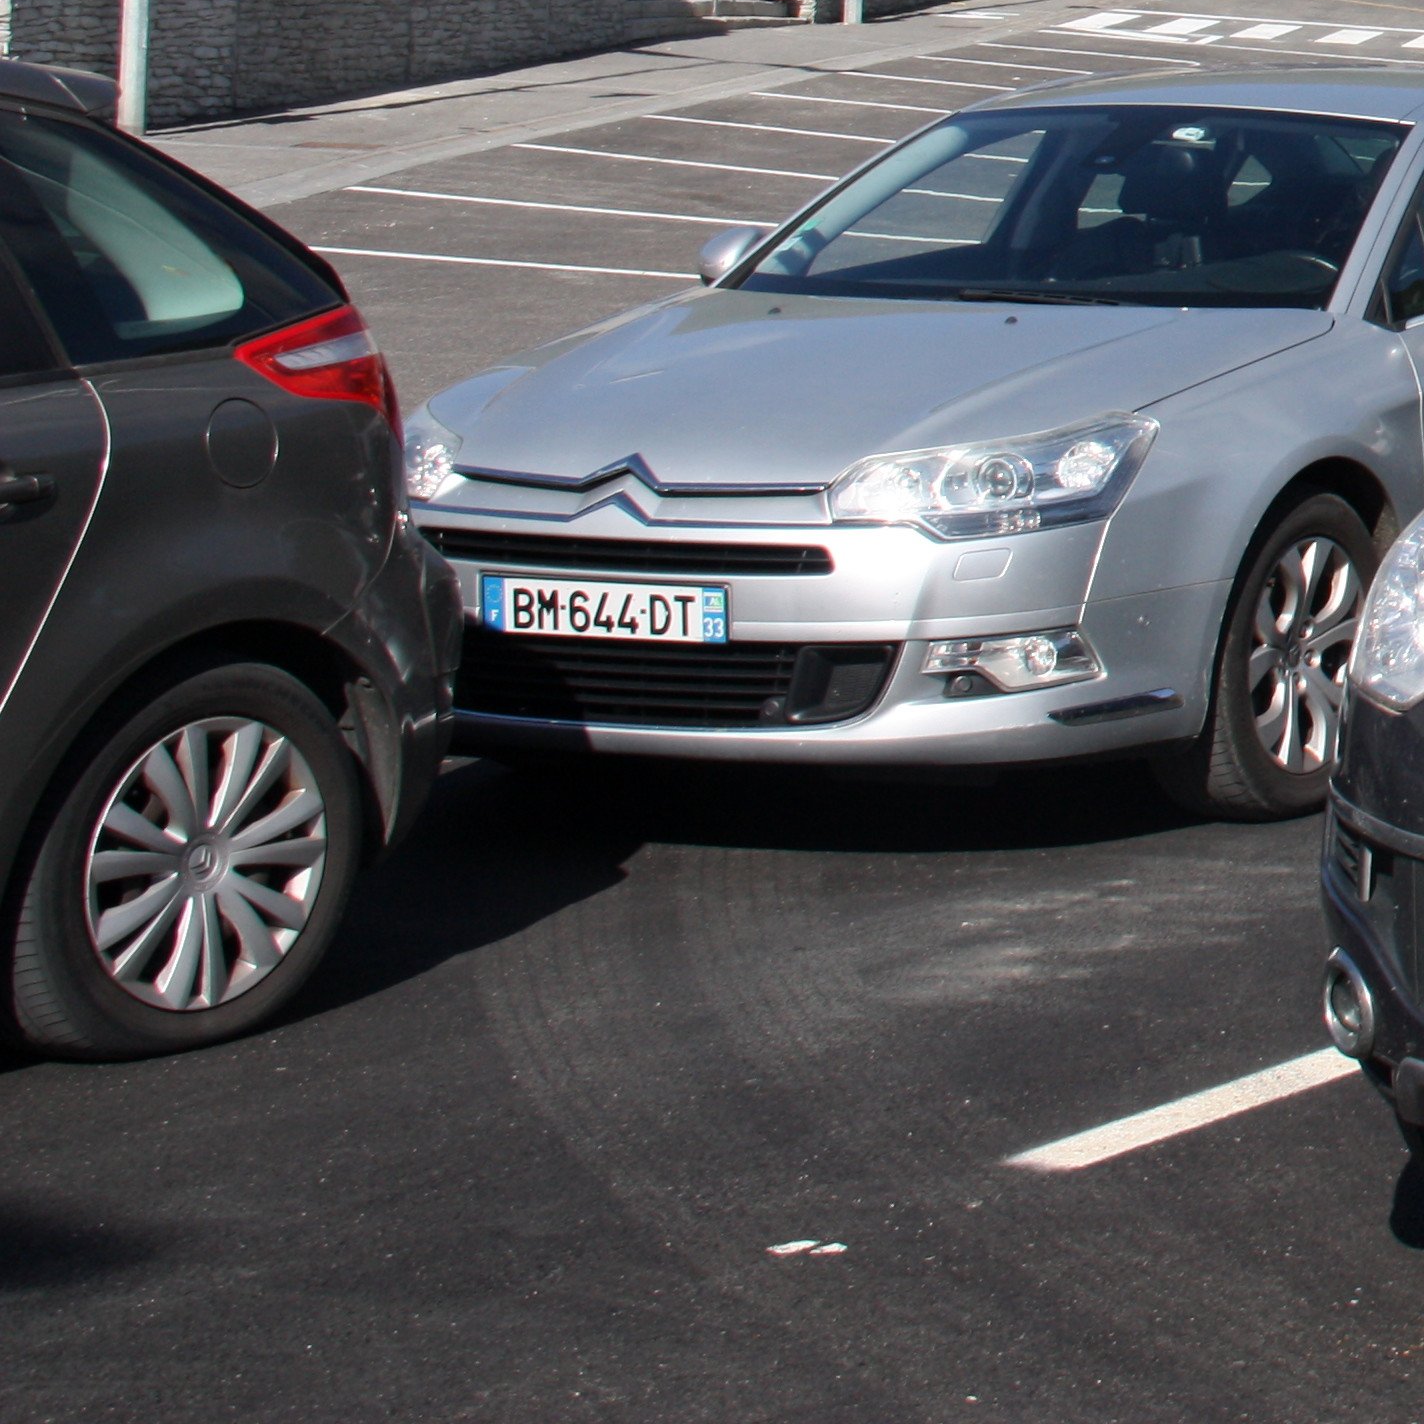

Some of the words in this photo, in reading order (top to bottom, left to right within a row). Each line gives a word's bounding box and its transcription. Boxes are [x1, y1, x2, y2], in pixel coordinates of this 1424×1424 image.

[490, 609, 499, 623] F
[513, 588, 696, 637] BM-644-DT
[704, 617, 724, 638] 33
